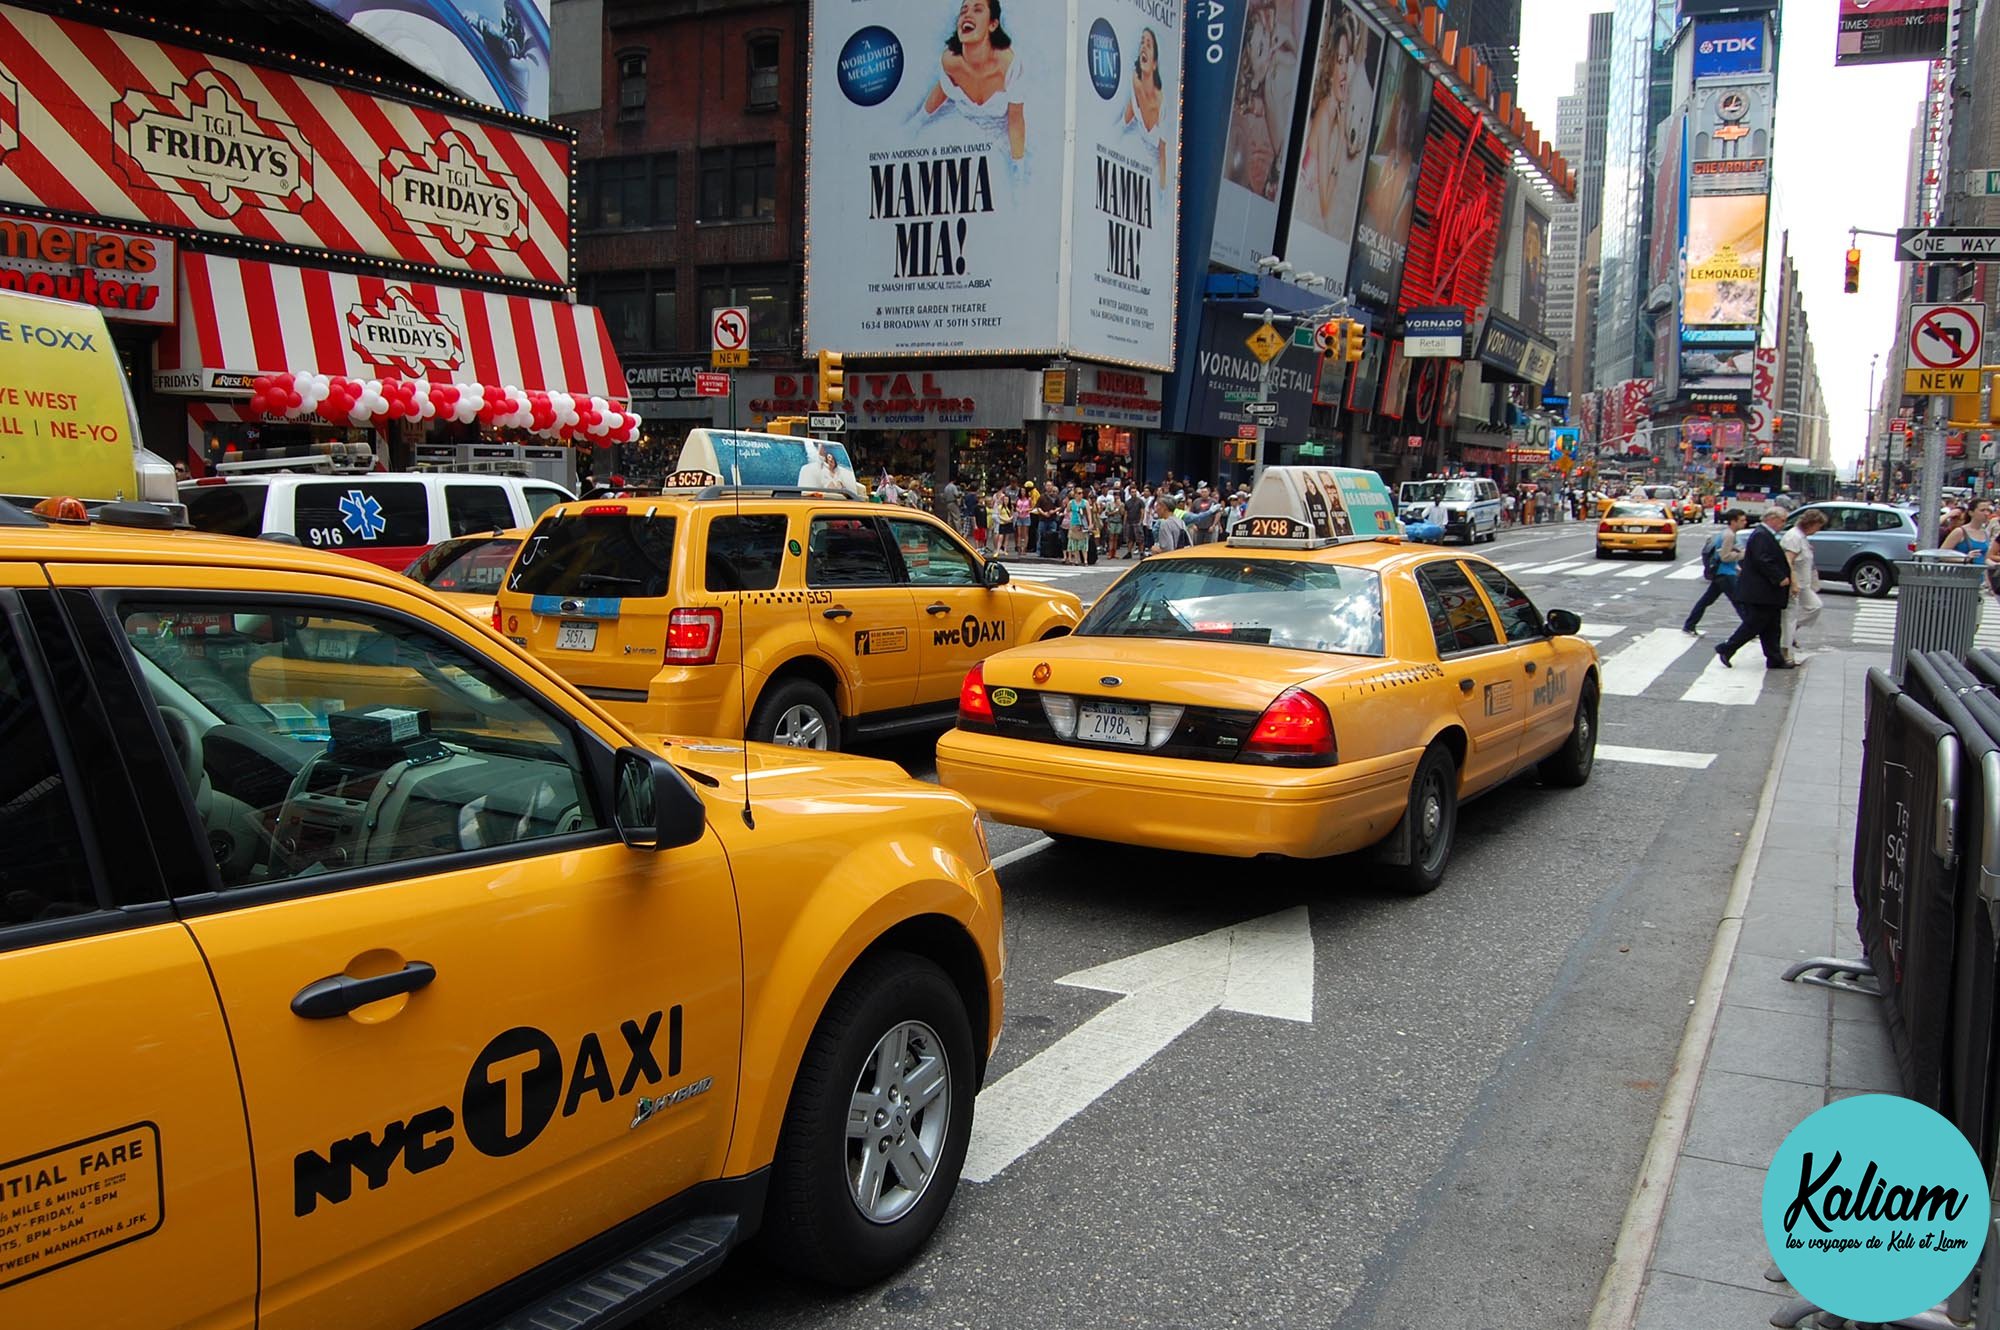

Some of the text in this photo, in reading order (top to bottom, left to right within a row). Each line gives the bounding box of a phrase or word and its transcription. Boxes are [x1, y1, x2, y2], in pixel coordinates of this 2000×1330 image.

[1713, 37, 1756, 53] TDK
[201, 115, 236, 138] T.G.I.
[145, 124, 288, 177] FRIDAY'S
[1694, 160, 1765, 174] CHEVROLET
[445, 169, 471, 188] T.G.I.
[869, 156, 994, 220] MAMMA
[404, 178, 510, 221] FRIDAY'S
[1095, 154, 1153, 229] MAMMA
[894, 217, 967, 278] MIA!
[1107, 219, 1141, 281] MIA!
[1913, 238, 1996, 252] ONE WAY
[1690, 268, 1756, 279] LEMONADE
[868, 284, 880, 292] THE
[881, 283, 904, 292] SMASH
[918, 281, 945, 290] MUSICAL
[1324, 277, 1343, 297] TOUS
[885, 303, 987, 315] WINTER GARDEN THEATRE
[883, 319, 930, 329] BROADWAY
[933, 319, 943, 328] AT
[971, 317, 1002, 327] STREET
[1405, 319, 1463, 328] VORNADO
[20, 324, 97, 352] FOXX
[366, 324, 447, 348] FRIDAY'S
[1419, 337, 1447, 348] Retail
[1486, 328, 1526, 363] VORNADO
[719, 352, 741, 363] NEW
[1200, 350, 1260, 382] VORNAD
[159, 373, 200, 388] FRIDAY'S
[626, 366, 703, 384] CAMERAS
[1920, 373, 1964, 389] NEW
[774, 374, 942, 398] DIITAL
[25, 390, 77, 411] WEST
[864, 399, 975, 413] COMPUTERS
[1690, 393, 1738, 401] Panasonic
[51, 421, 117, 443] NE-YO
[678, 472, 703, 486] 5C57
[310, 527, 343, 546] 916
[1252, 519, 1288, 536] 2Y98
[807, 590, 833, 604] 5C57
[564, 629, 586, 644] 5C57A
[934, 630, 960, 646] NYC
[961, 614, 1006, 648] TAXI
[1094, 714, 1131, 736] 2Y98A
[652, 1076, 714, 1112] HYBRID
[294, 1004, 682, 1217] NYC TAXI
[80, 1139, 143, 1176] FARE
[12, 1181, 101, 1218] MILE & MINUTE
[44, 1225, 114, 1257] MANHATTAN
[116, 1221, 124, 1230] &
[126, 1213, 147, 1228] JFK
